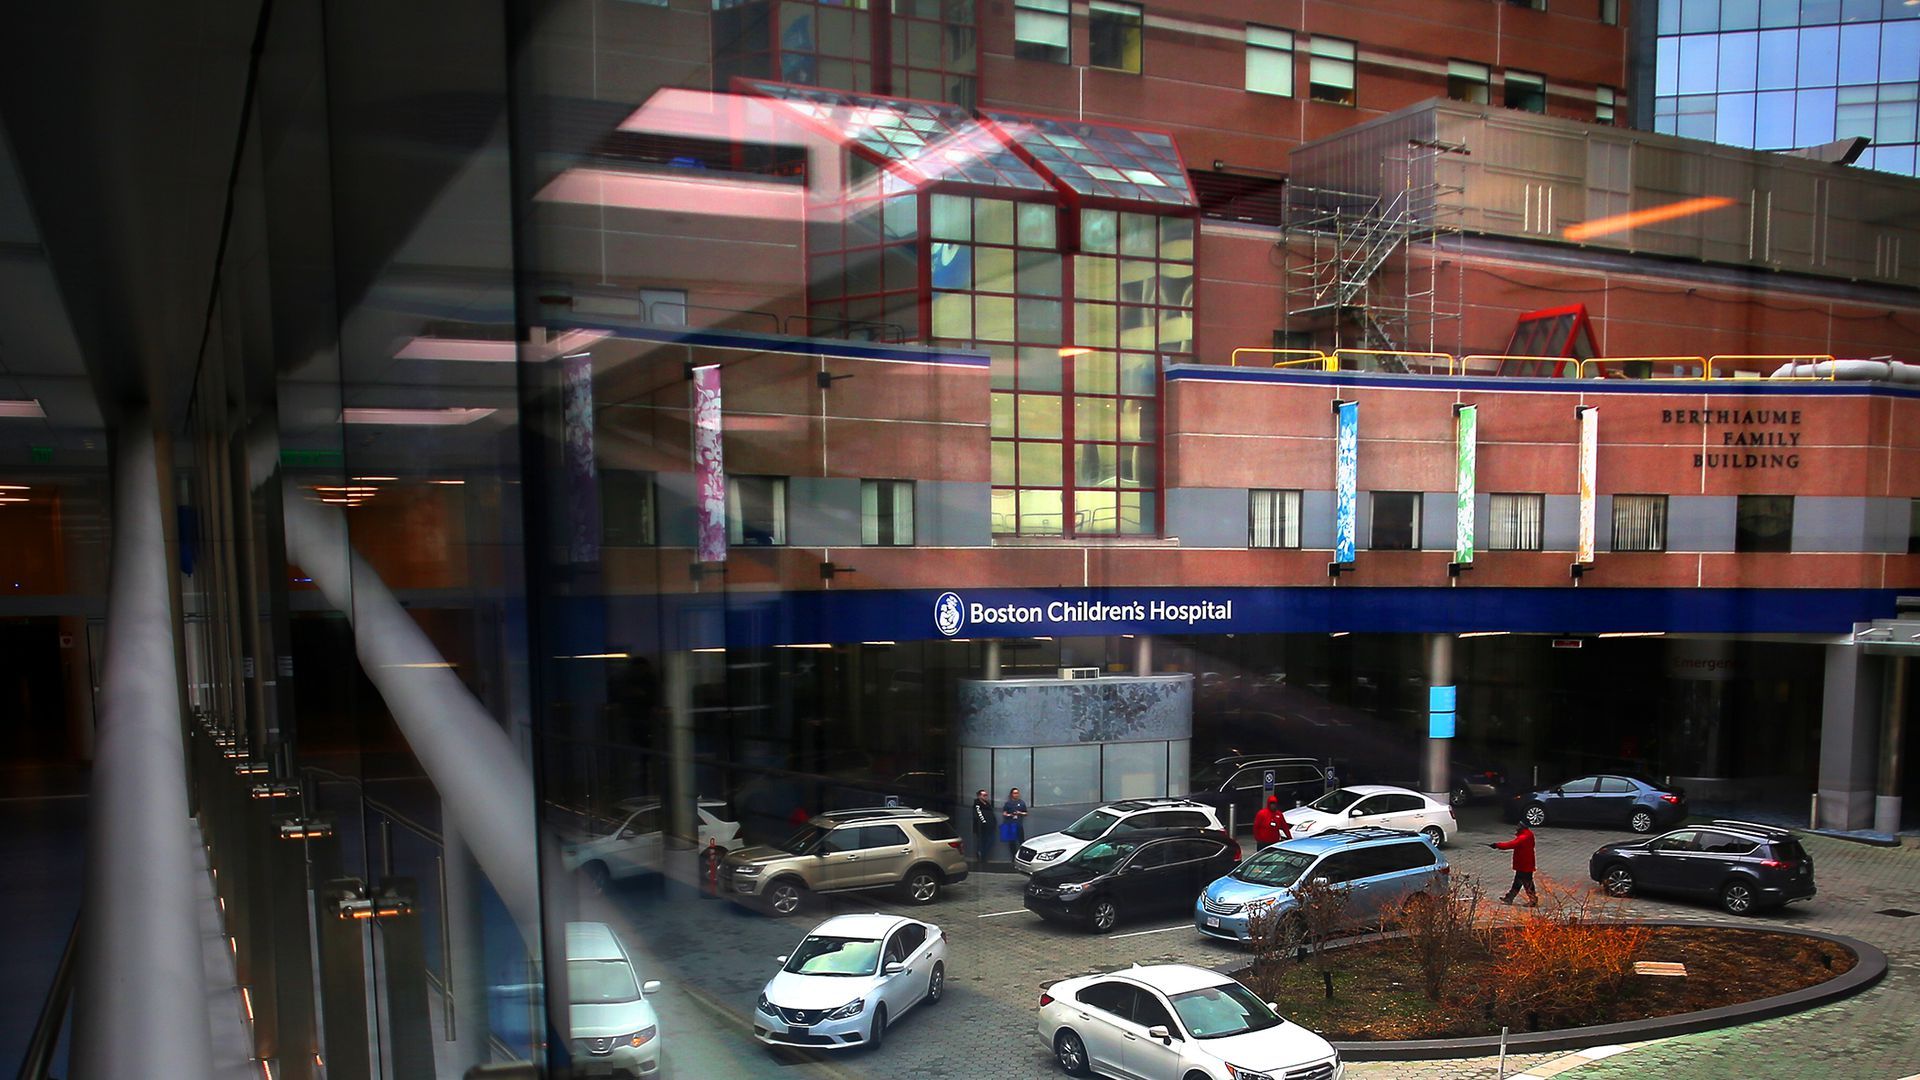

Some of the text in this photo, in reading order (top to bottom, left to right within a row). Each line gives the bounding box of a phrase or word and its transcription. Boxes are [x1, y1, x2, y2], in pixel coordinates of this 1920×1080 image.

[1662, 410, 1801, 424] BERTHIAUME
[1724, 432, 1801, 446] FAMILY
[1693, 454, 1800, 468] BUILDING
[970, 600, 1232, 625] Boston Children's Hospital
[1673, 656, 1744, 671] Emergen
